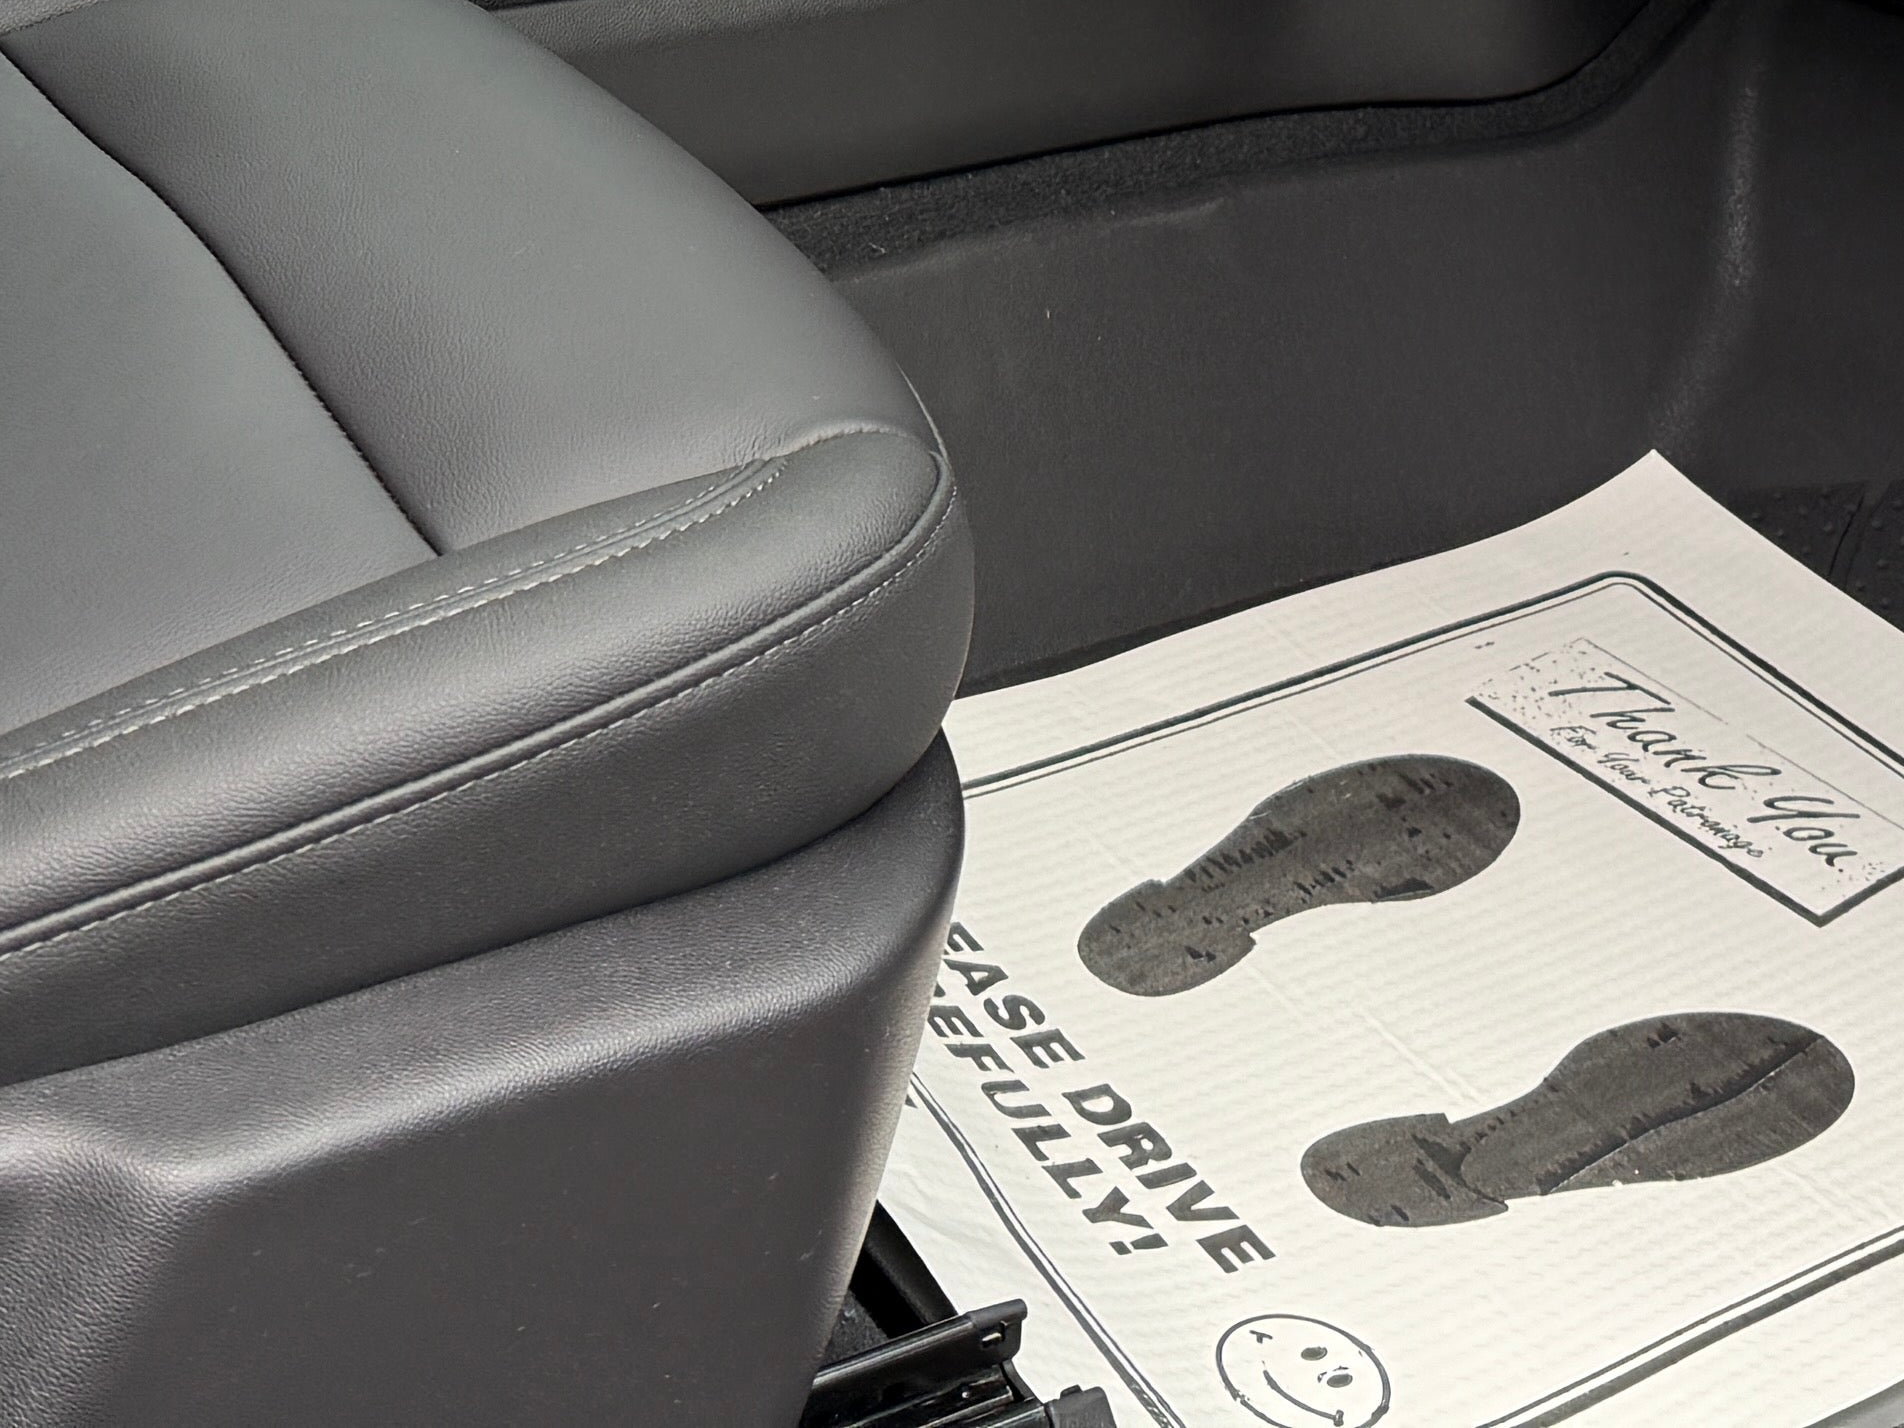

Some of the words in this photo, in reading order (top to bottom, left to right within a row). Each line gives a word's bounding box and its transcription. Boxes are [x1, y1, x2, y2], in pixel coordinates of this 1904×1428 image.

[1548, 671, 1783, 790] Thank
[1746, 795, 1862, 868] You
[1548, 724, 1597, 750] For
[1597, 752, 1651, 785] Your
[1647, 786, 1765, 858] Patronage
[927, 1002, 1169, 1256] EFULLY!
[943, 920, 1086, 1069] EASE
[1061, 1082, 1277, 1274] DRIVE
